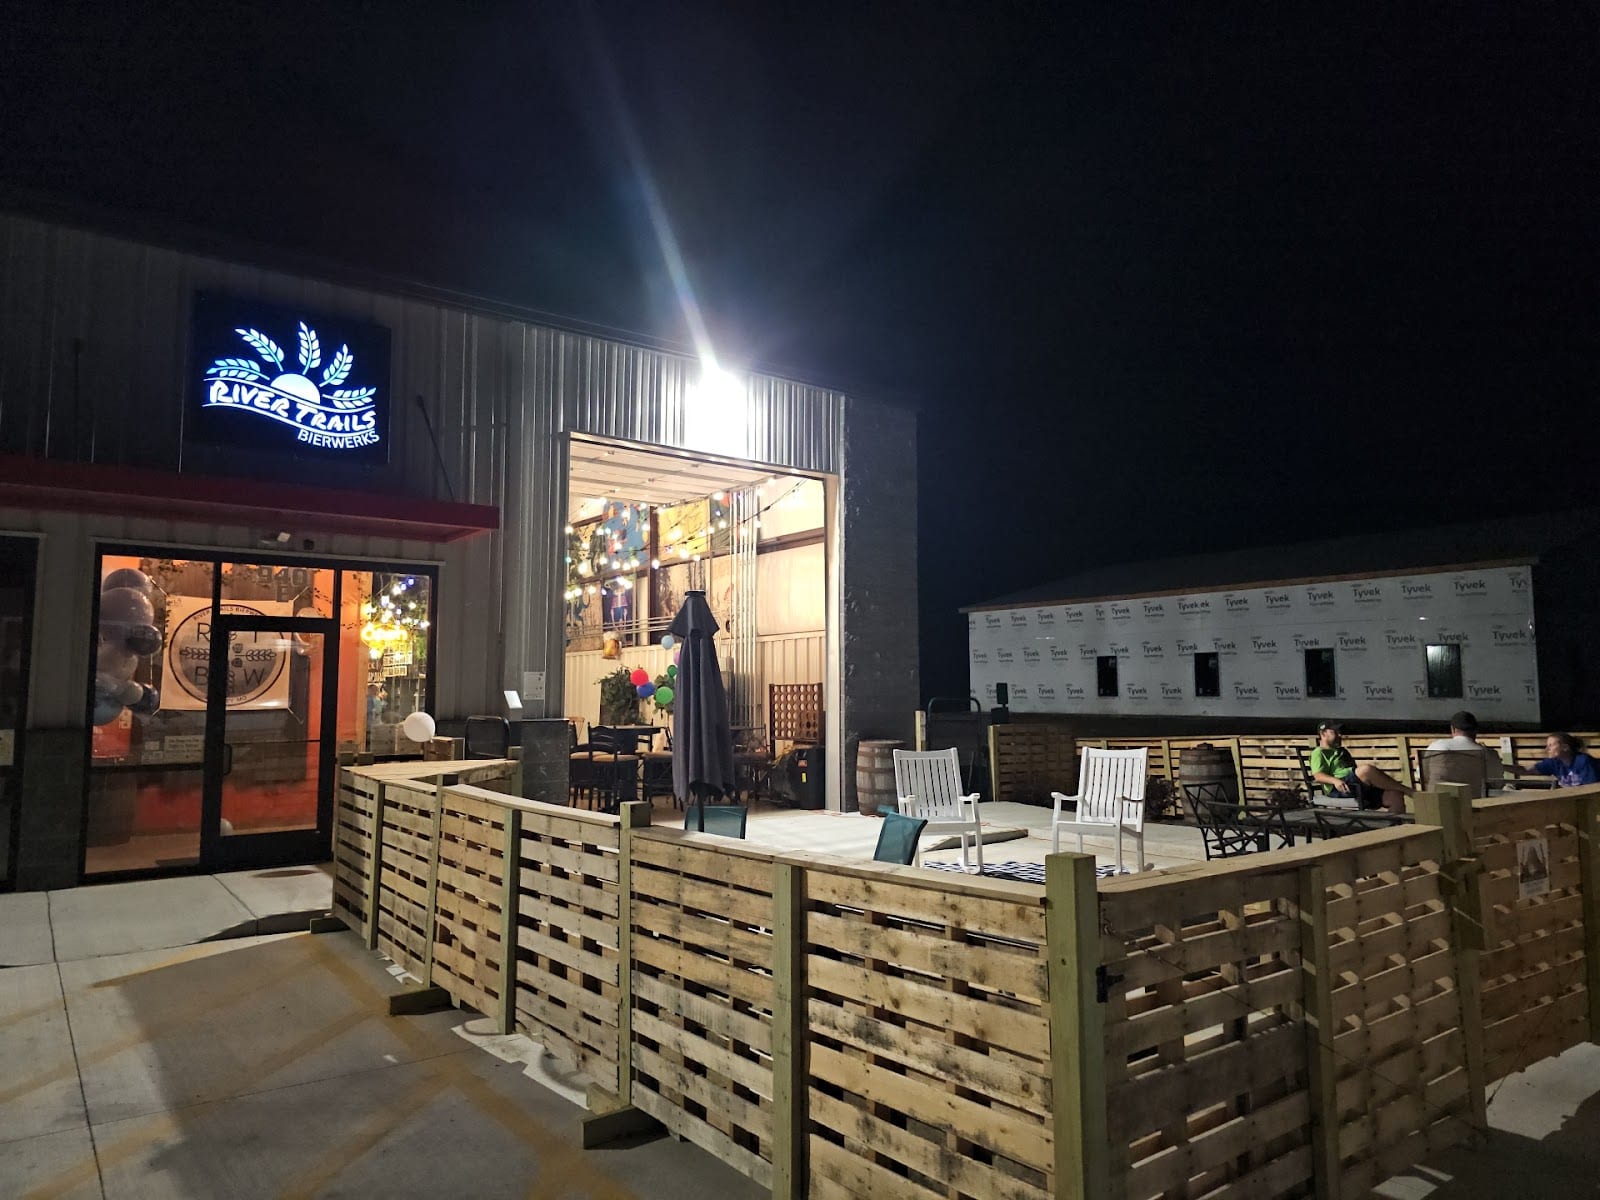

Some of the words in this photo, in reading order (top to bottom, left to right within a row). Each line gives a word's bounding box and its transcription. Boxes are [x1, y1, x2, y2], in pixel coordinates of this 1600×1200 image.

[209, 381, 290, 417] RIVER
[295, 404, 376, 433] TRAILS
[297, 429, 380, 449] BIERWERKS
[1401, 584, 1431, 595] Tyvek
[1454, 579, 1486, 591] Tyvek
[1308, 591, 1334, 600] Tyvek
[1353, 587, 1381, 597] Tyvek
[1225, 598, 1249, 606] Tyvek
[1265, 594, 1289, 603] Tyvek
[1144, 604, 1164, 613] Tyvek
[1178, 602, 1199, 610] Tyvek
[1386, 634, 1416, 645] Tyvek
[1438, 632, 1468, 643] Tyvek
[1493, 629, 1527, 642] Tyvek
[1253, 640, 1276, 649] Tyvek
[1339, 636, 1366, 647] Tyvek
[1143, 645, 1162, 653] Tyvek
[1177, 643, 1198, 652] Tyvek
[244, 667, 265, 686] W
[1066, 687, 1084, 695] Tyvek
[1127, 687, 1147, 695] Tyvek
[1161, 687, 1182, 695] Tyvek
[1234, 686, 1258, 695] Tyvek
[1275, 686, 1300, 696] Tyvek
[1364, 685, 1393, 696] Tyvek
[1467, 685, 1501, 696] Tyvek
